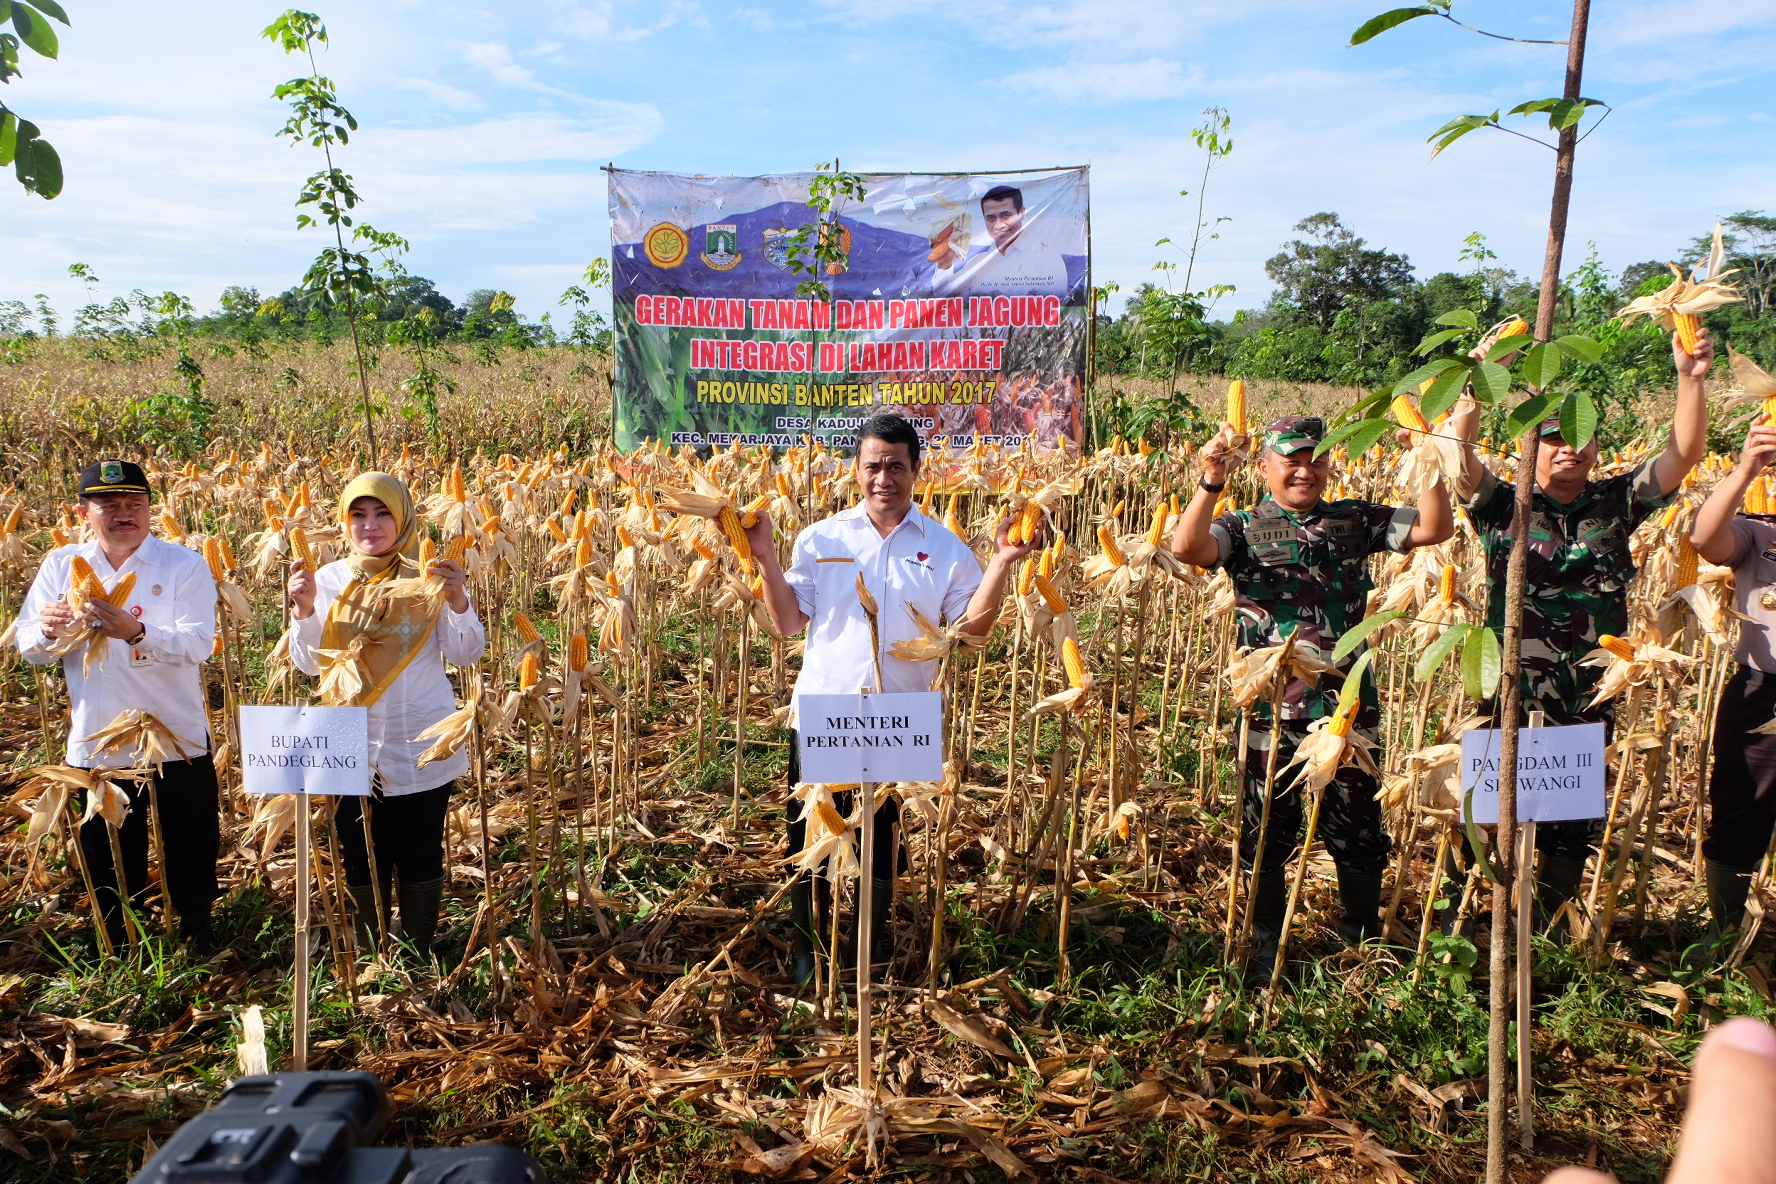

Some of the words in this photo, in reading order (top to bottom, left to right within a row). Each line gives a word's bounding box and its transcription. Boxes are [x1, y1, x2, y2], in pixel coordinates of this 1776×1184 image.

[635, 295, 745, 329] GERAKAN
[749, 299, 832, 331] TANAM
[835, 300, 884, 330] DAN
[889, 297, 963, 330] PANEN
[967, 295, 1061, 328] JAGUNG
[690, 338, 814, 373] INTEGRASI
[818, 342, 846, 373] DI
[850, 340, 925, 373] LAHAN
[929, 339, 1005, 371] KARET
[697, 380, 788, 405] PROVINSI
[794, 384, 873, 407] BANTEN
[878, 381, 947, 405] TAHUN
[951, 381, 996, 404] 2017
[776, 417, 814, 429] DESA
[671, 432, 705, 444] KEC.
[795, 435, 830, 447] KB.
[952, 435, 1002, 447] MAET
[1252, 530, 1290, 542] BUDI
[826, 716, 910, 729] MENTERI
[271, 735, 330, 749] BUPATI
[806, 735, 903, 748] PERTANIAN
[912, 734, 930, 747] RI
[248, 754, 357, 769] PANDEGLANG
[1576, 753, 1593, 768] III
[1484, 775, 1582, 793] SIWANGI
